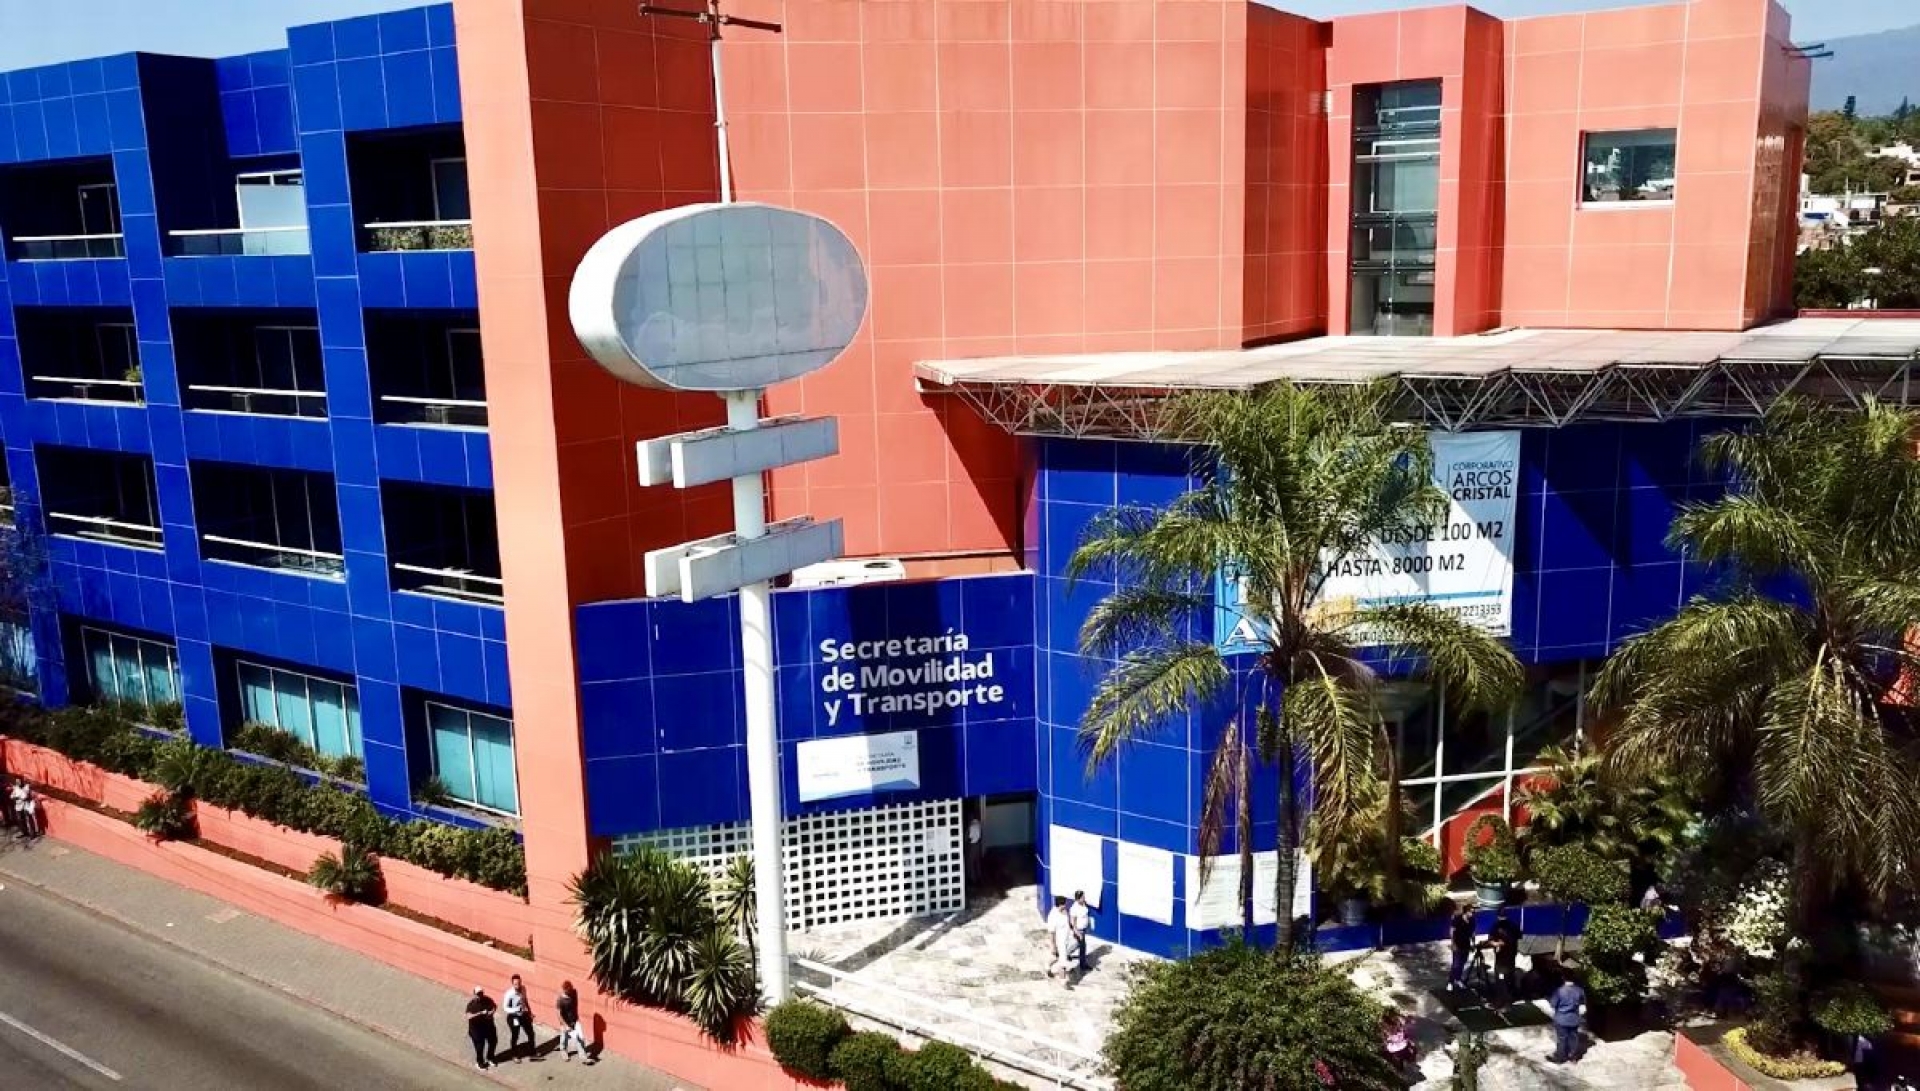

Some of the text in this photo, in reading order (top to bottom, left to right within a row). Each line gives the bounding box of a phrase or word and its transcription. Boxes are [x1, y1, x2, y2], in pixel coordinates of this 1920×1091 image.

[1453, 461, 1513, 471] CORPORATIVO
[1453, 470, 1512, 487] ARCOS
[1452, 486, 1511, 501] CRISTAL
[1380, 525, 1436, 544] DESDE
[1441, 522, 1472, 541] 100
[1476, 521, 1504, 540] M2
[1327, 553, 1465, 577] HASTA 8000 M2
[819, 627, 969, 662] Secretaría
[821, 652, 993, 692] de Movilidad
[823, 683, 1004, 726] y Transporte
